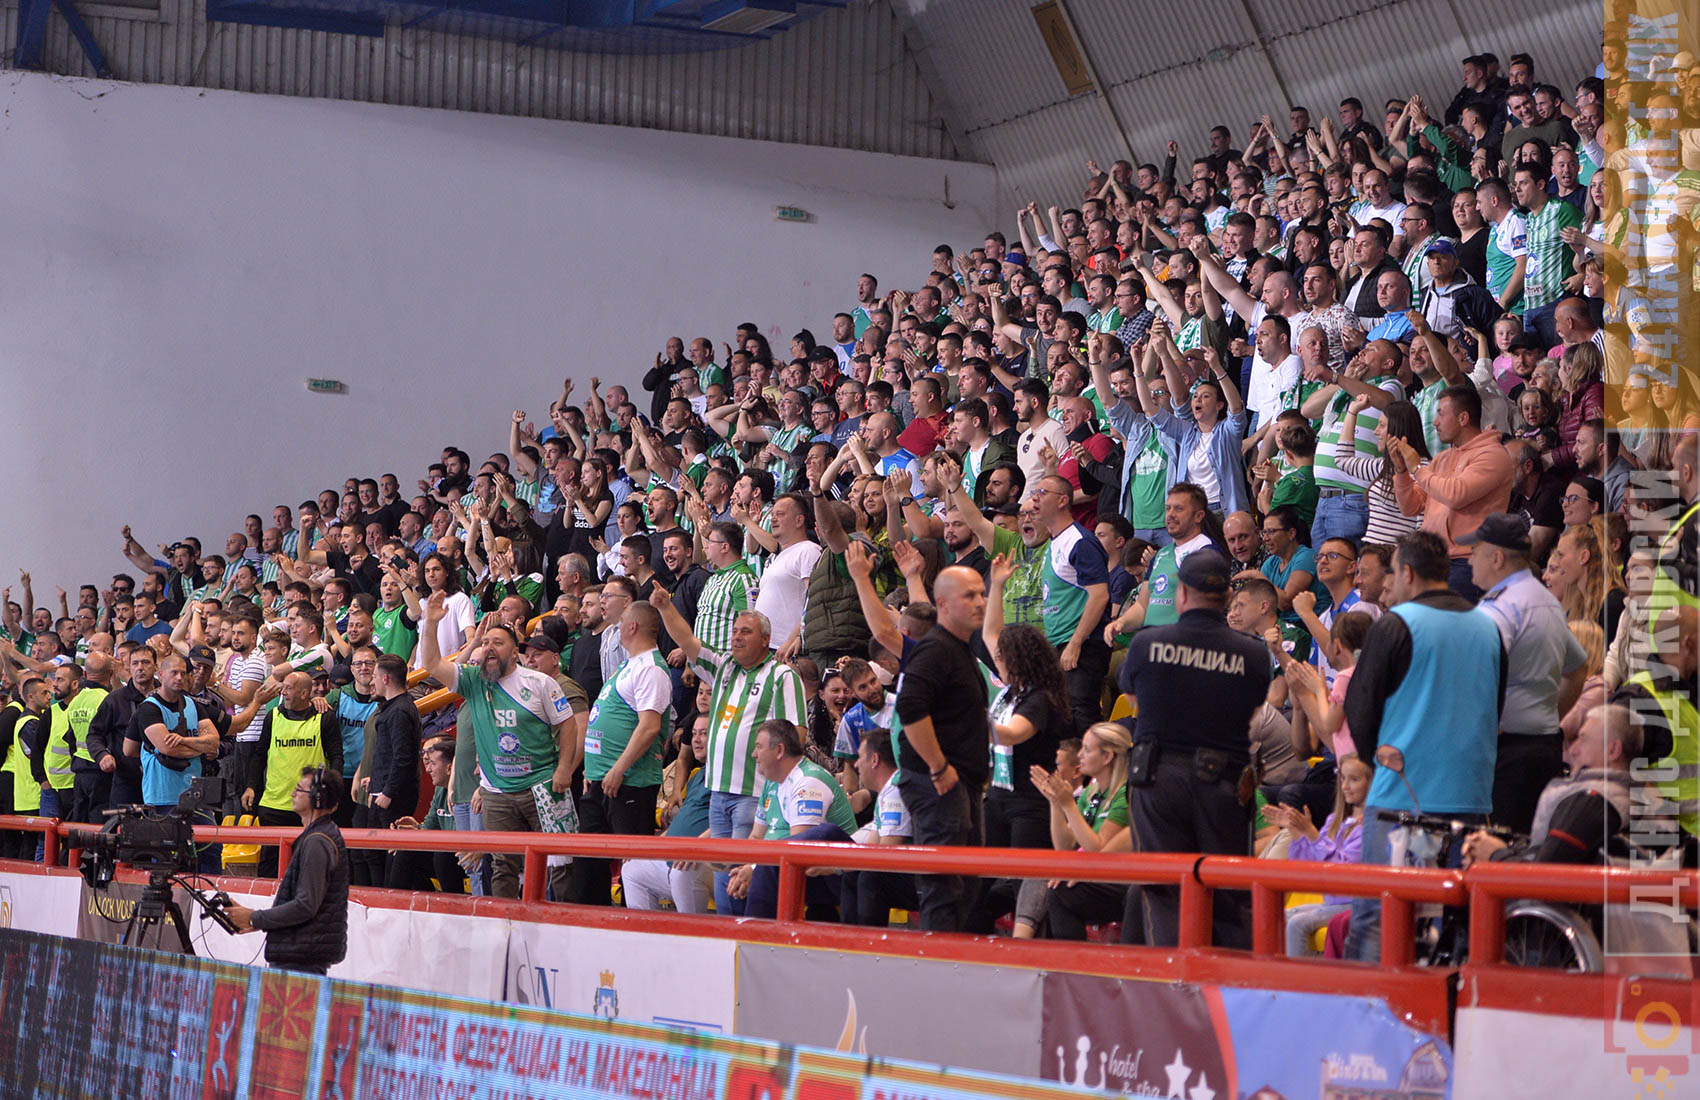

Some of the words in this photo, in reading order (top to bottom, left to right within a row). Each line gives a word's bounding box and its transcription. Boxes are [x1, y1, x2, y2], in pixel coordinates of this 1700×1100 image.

[1149, 642, 1245, 676] ПОЛИЦИЈА
[340, 714, 366, 728] hum
[494, 709, 517, 728] 59
[274, 735, 316, 748] hummel
[1108, 1044, 1144, 1080] hotel
